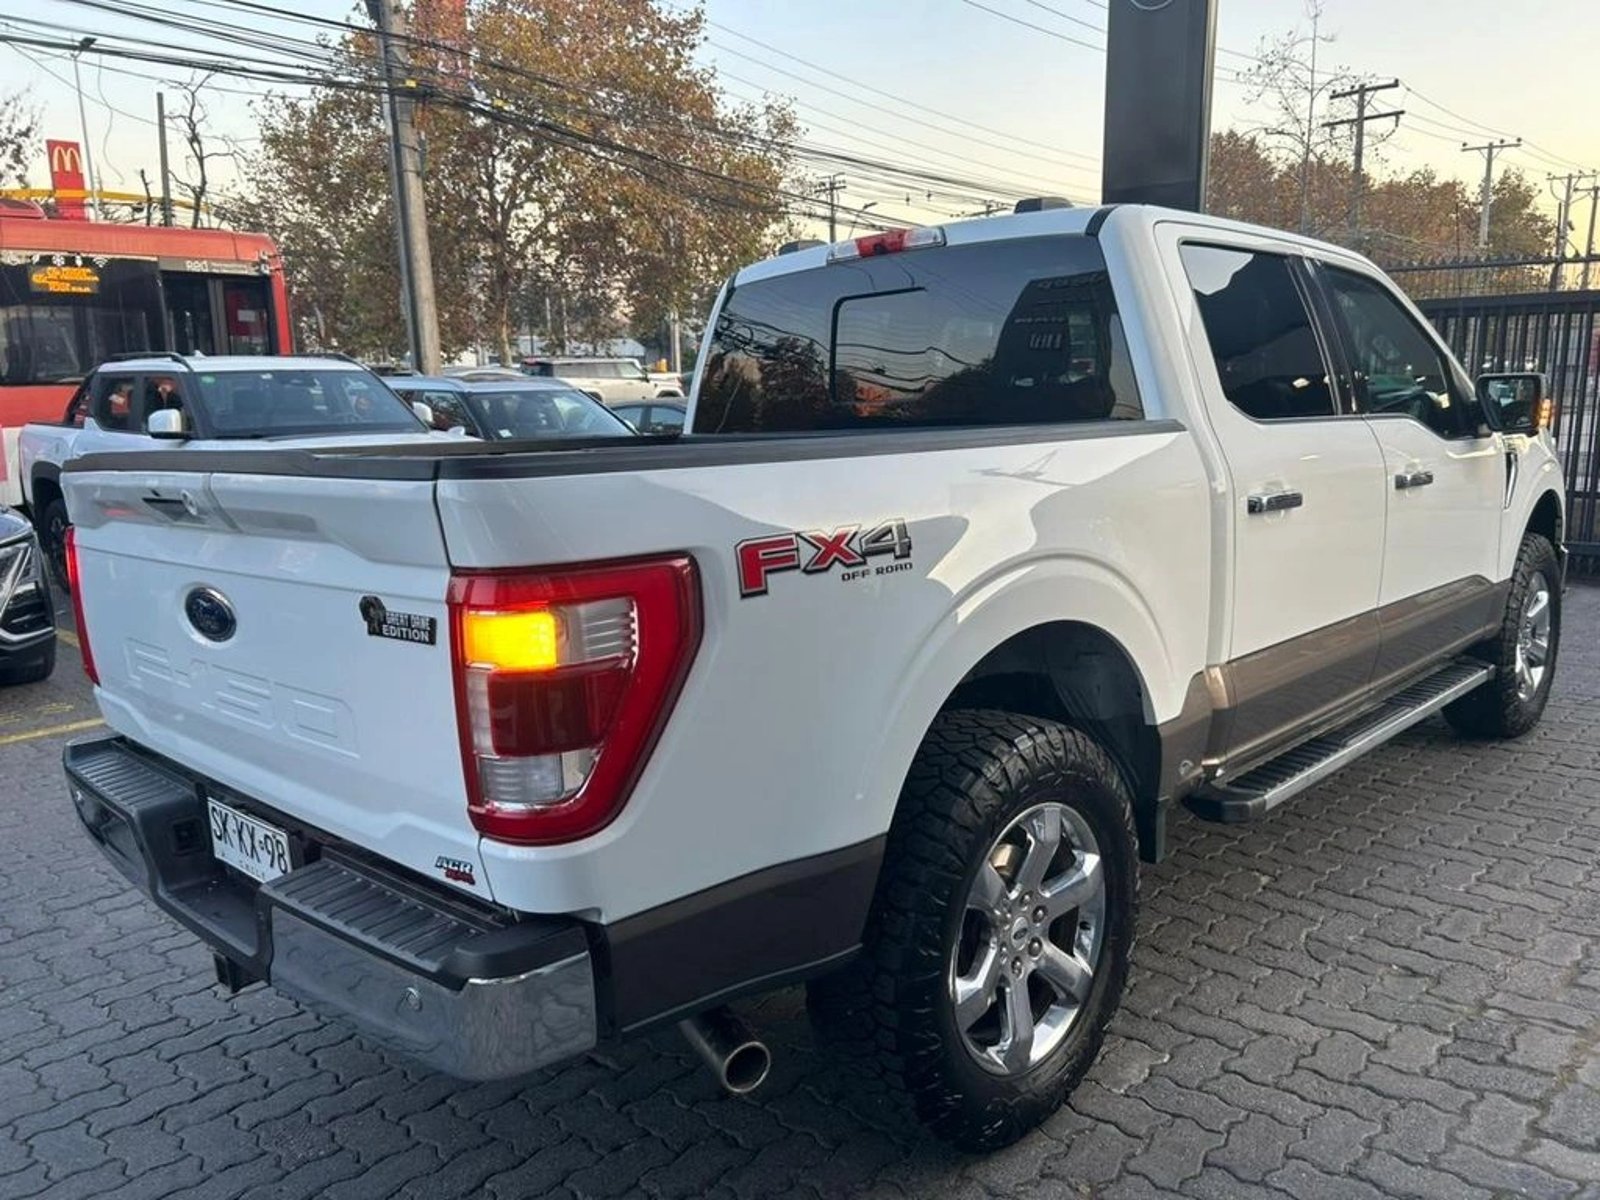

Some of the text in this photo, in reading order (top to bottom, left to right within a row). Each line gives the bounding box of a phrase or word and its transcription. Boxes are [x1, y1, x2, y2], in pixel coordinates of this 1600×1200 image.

[734, 517, 912, 600] FX4
[841, 562, 913, 583] OFF ROAD
[382, 624, 430, 642] EDITION
